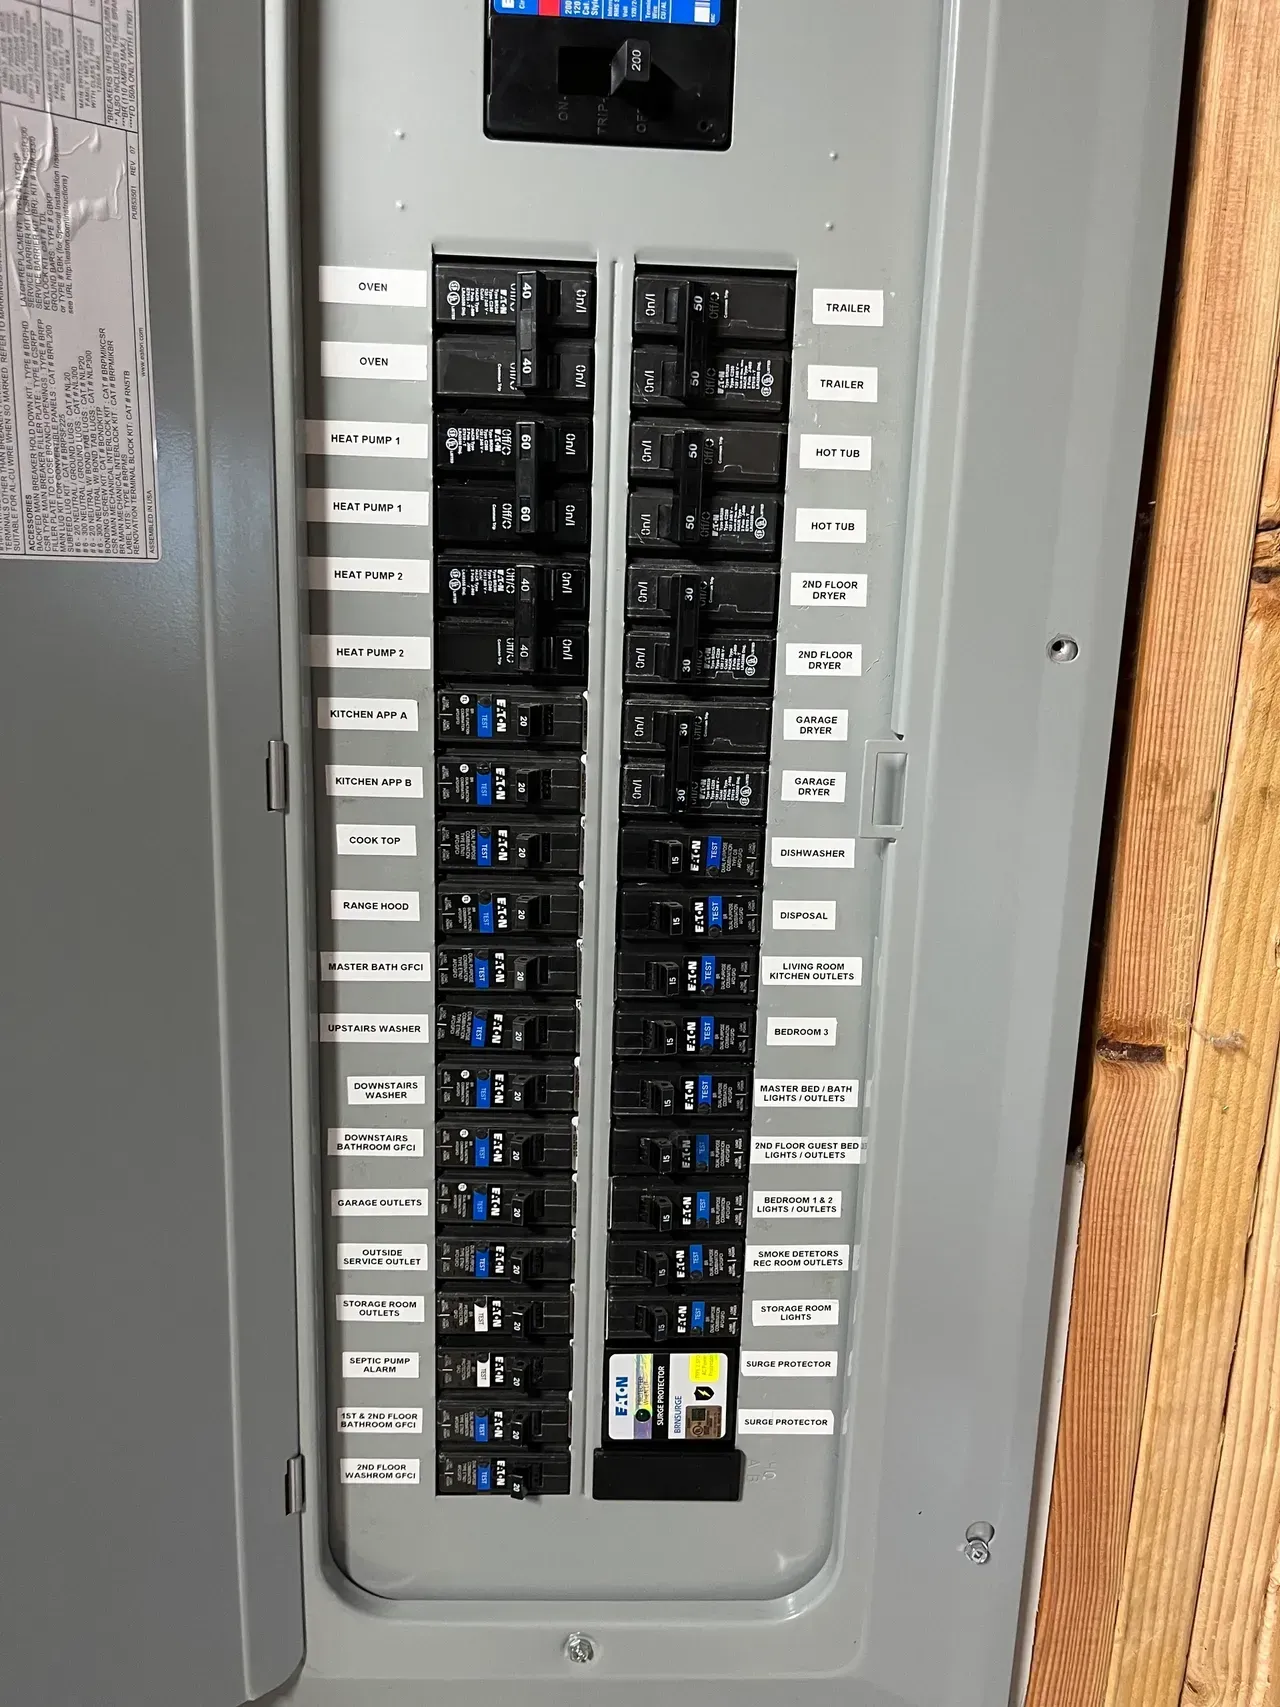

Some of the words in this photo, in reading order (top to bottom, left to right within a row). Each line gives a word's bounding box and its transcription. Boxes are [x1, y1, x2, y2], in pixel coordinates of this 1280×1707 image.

[631, 49, 642, 72] 200
[358, 282, 388, 292] OVEN
[522, 281, 532, 299] 40
[694, 295, 703, 312] 50
[826, 304, 870, 312] TRAILER
[360, 356, 388, 366] OVEN
[522, 357, 532, 374] 40
[691, 370, 700, 387] 50
[820, 380, 864, 390] TRAILER
[330, 434, 358, 444] HEAT
[362, 436, 392, 444] PUMP
[396, 436, 400, 444] 1
[521, 434, 532, 450] 60
[688, 443, 698, 459] 50
[816, 448, 838, 456] HOT
[840, 448, 860, 458] TUB
[334, 502, 360, 510] HEAT
[364, 502, 394, 512] PUMP
[398, 504, 402, 512] 1
[520, 506, 531, 522] 60
[26, 495, 35, 551] ACCESSORIES
[685, 515, 695, 530] 50
[812, 522, 832, 530] HOT
[834, 522, 854, 530] TUB
[334, 570, 362, 578] HEAT
[364, 572, 394, 580] PUMP
[398, 572, 402, 580] 2
[520, 578, 530, 592] 40
[802, 580, 822, 588] 2ND
[824, 580, 858, 590] FLOOR
[685, 587, 694, 602] 30
[812, 592, 846, 600] DRYER
[336, 648, 364, 656] HEAT
[366, 648, 396, 656] PUMP
[398, 650, 404, 658] 2
[519, 644, 529, 658] 40
[798, 650, 818, 658] 2ND
[820, 650, 852, 660] FLOOR
[682, 659, 691, 673] 30
[808, 662, 842, 670] DRYER
[330, 710, 374, 718] KITCHEN
[376, 710, 398, 720] APP
[400, 712, 408, 720] A
[796, 716, 838, 724] GARAGE
[519, 715, 528, 727] 20
[679, 723, 688, 736] 30
[800, 726, 832, 734] DRYER
[334, 776, 378, 786] KITCHEN
[382, 778, 402, 786] APP
[404, 778, 412, 786] B
[794, 778, 836, 786] GARAGE
[676, 788, 686, 802] 30
[798, 788, 830, 796] DRYER
[350, 836, 378, 844] COOK
[380, 836, 400, 844] TOP
[780, 850, 844, 858] DISHWASHER
[671, 856, 680, 865] 15
[344, 902, 378, 910] RANGE
[380, 902, 408, 910] HOOD
[711, 901, 719, 920] TEST
[780, 912, 828, 920] DISPOSAL
[328, 962, 368, 970] MASTER
[782, 962, 814, 970] LIVING
[816, 962, 844, 970] ROOM
[812, 972, 854, 980] OUTLETS
[328, 1024, 376, 1032] UPSTAIRS
[354, 1082, 418, 1090] DOWNSTAIRS
[760, 1084, 798, 1092] MASTER
[798, 1094, 802, 1102] /
[804, 1094, 846, 1102] OUTLETS
[344, 1134, 408, 1142] DOWNSTAIRS
[394, 1144, 416, 1152] GFCI
[513, 1207, 521, 1218] 20
[804, 1258, 844, 1266] OUTLETS
[657, 1366, 665, 1402] PROTECTOR
[674, 1396, 682, 1434] BRNSURGE
